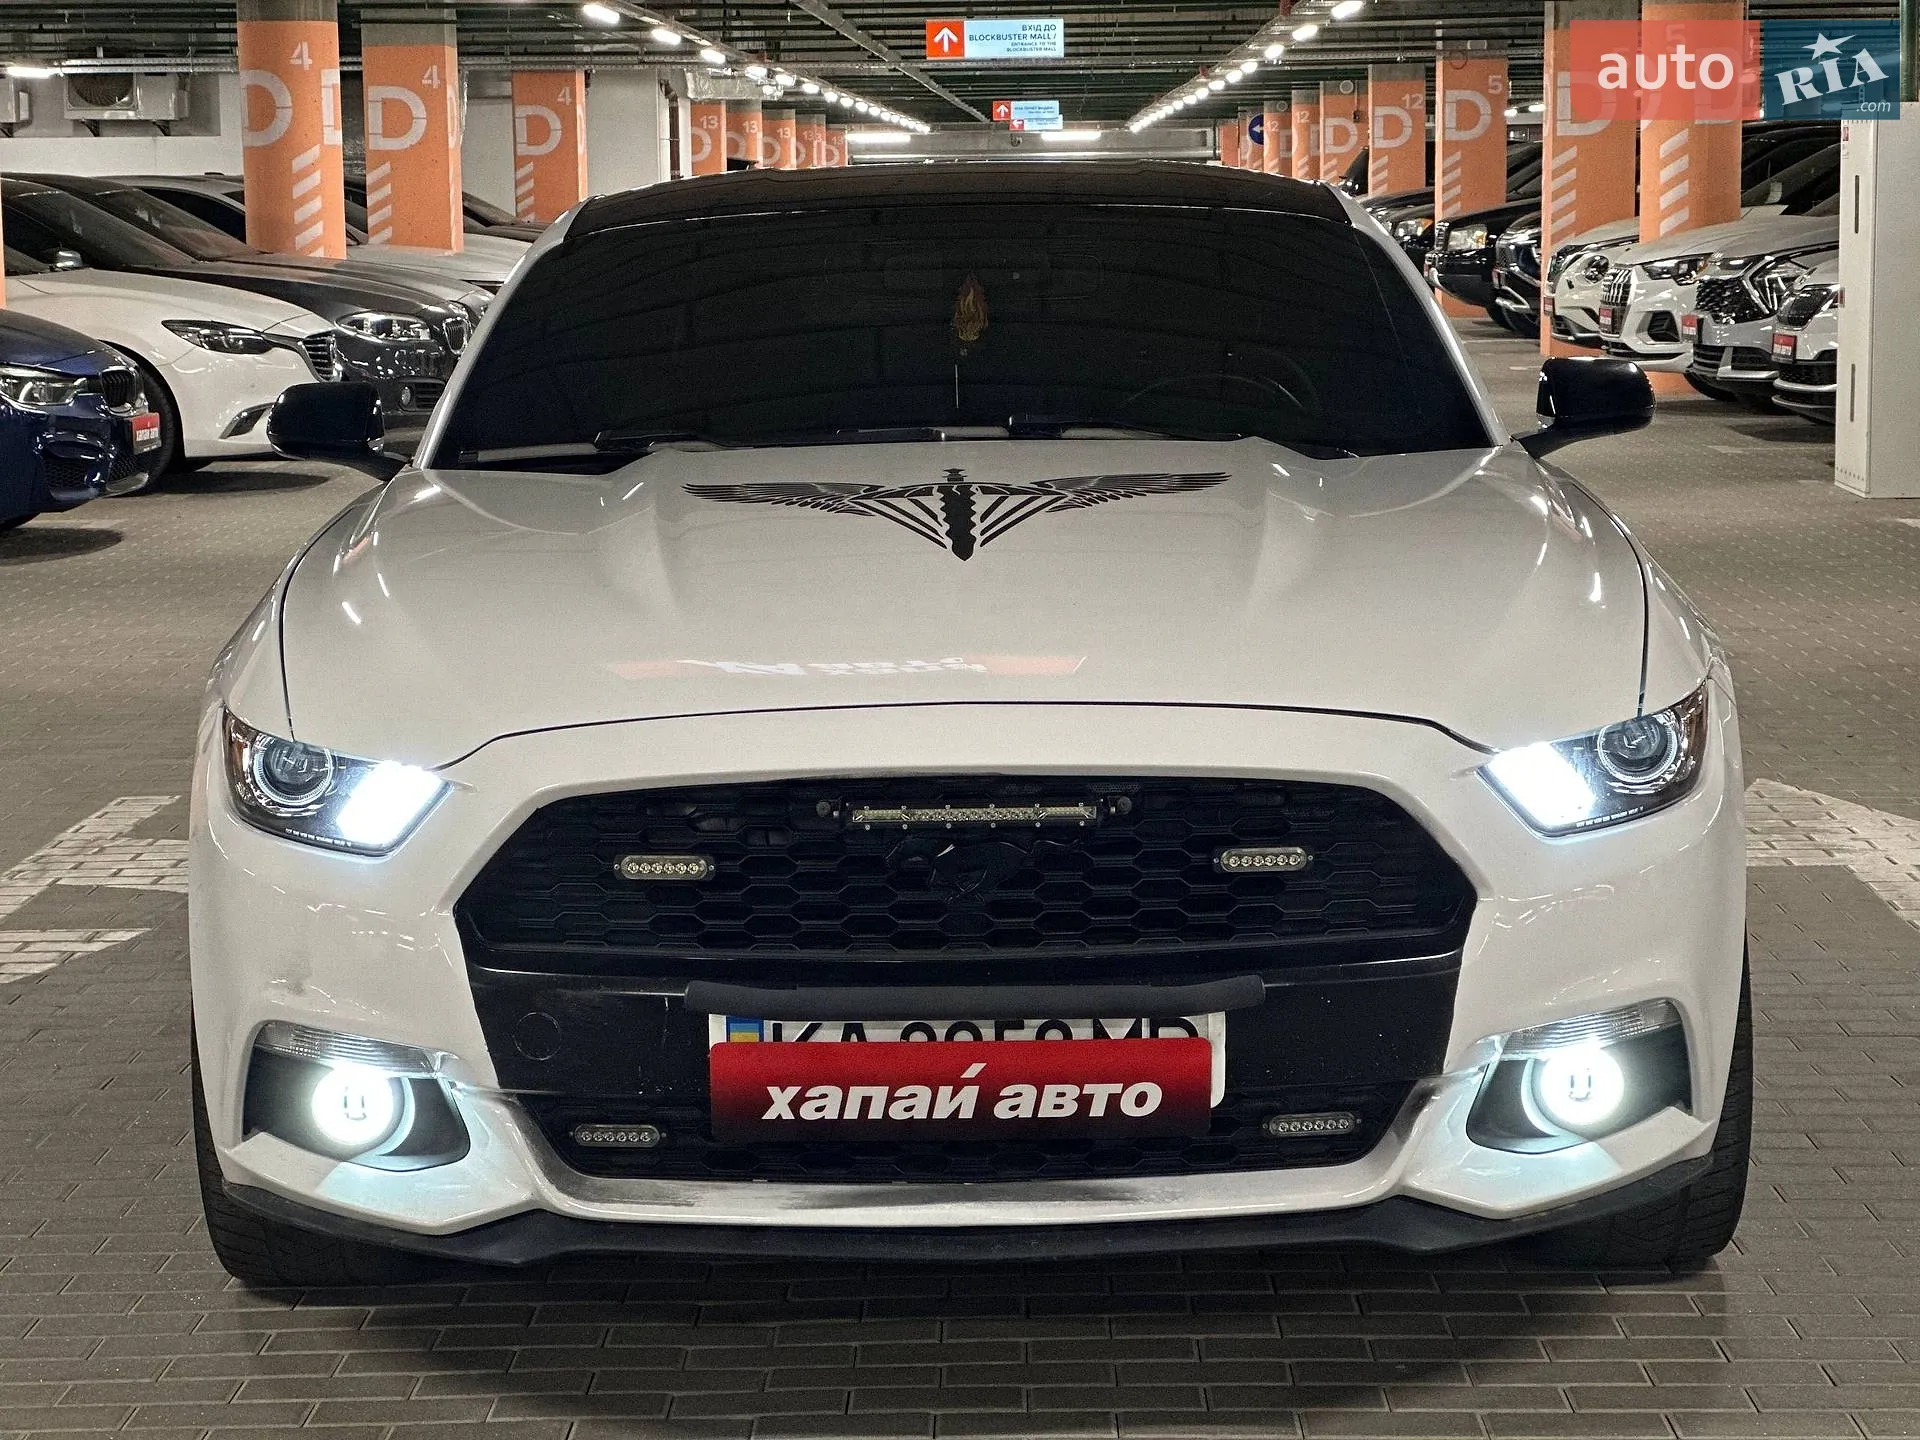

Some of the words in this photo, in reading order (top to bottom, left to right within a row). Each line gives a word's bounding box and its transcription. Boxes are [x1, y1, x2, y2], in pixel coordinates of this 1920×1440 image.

[969, 33, 1028, 41] BLOCKBUSTER
[1021, 24, 1042, 32] ВХІД
[1043, 24, 1057, 32] ДО
[289, 41, 313, 71] 4
[421, 65, 441, 89] 4
[1487, 74, 1503, 95] 5
[240, 69, 293, 147] D
[557, 86, 572, 106] 4
[1401, 93, 1424, 109] 12
[368, 85, 427, 150] D
[700, 115, 719, 130] 13
[742, 120, 759, 134] 13
[1374, 105, 1413, 149] D
[1445, 89, 1492, 141] D
[514, 104, 562, 156] D
[777, 127, 791, 139] 13
[1324, 116, 1358, 154] D
[992, 1081, 1164, 1119] авто
